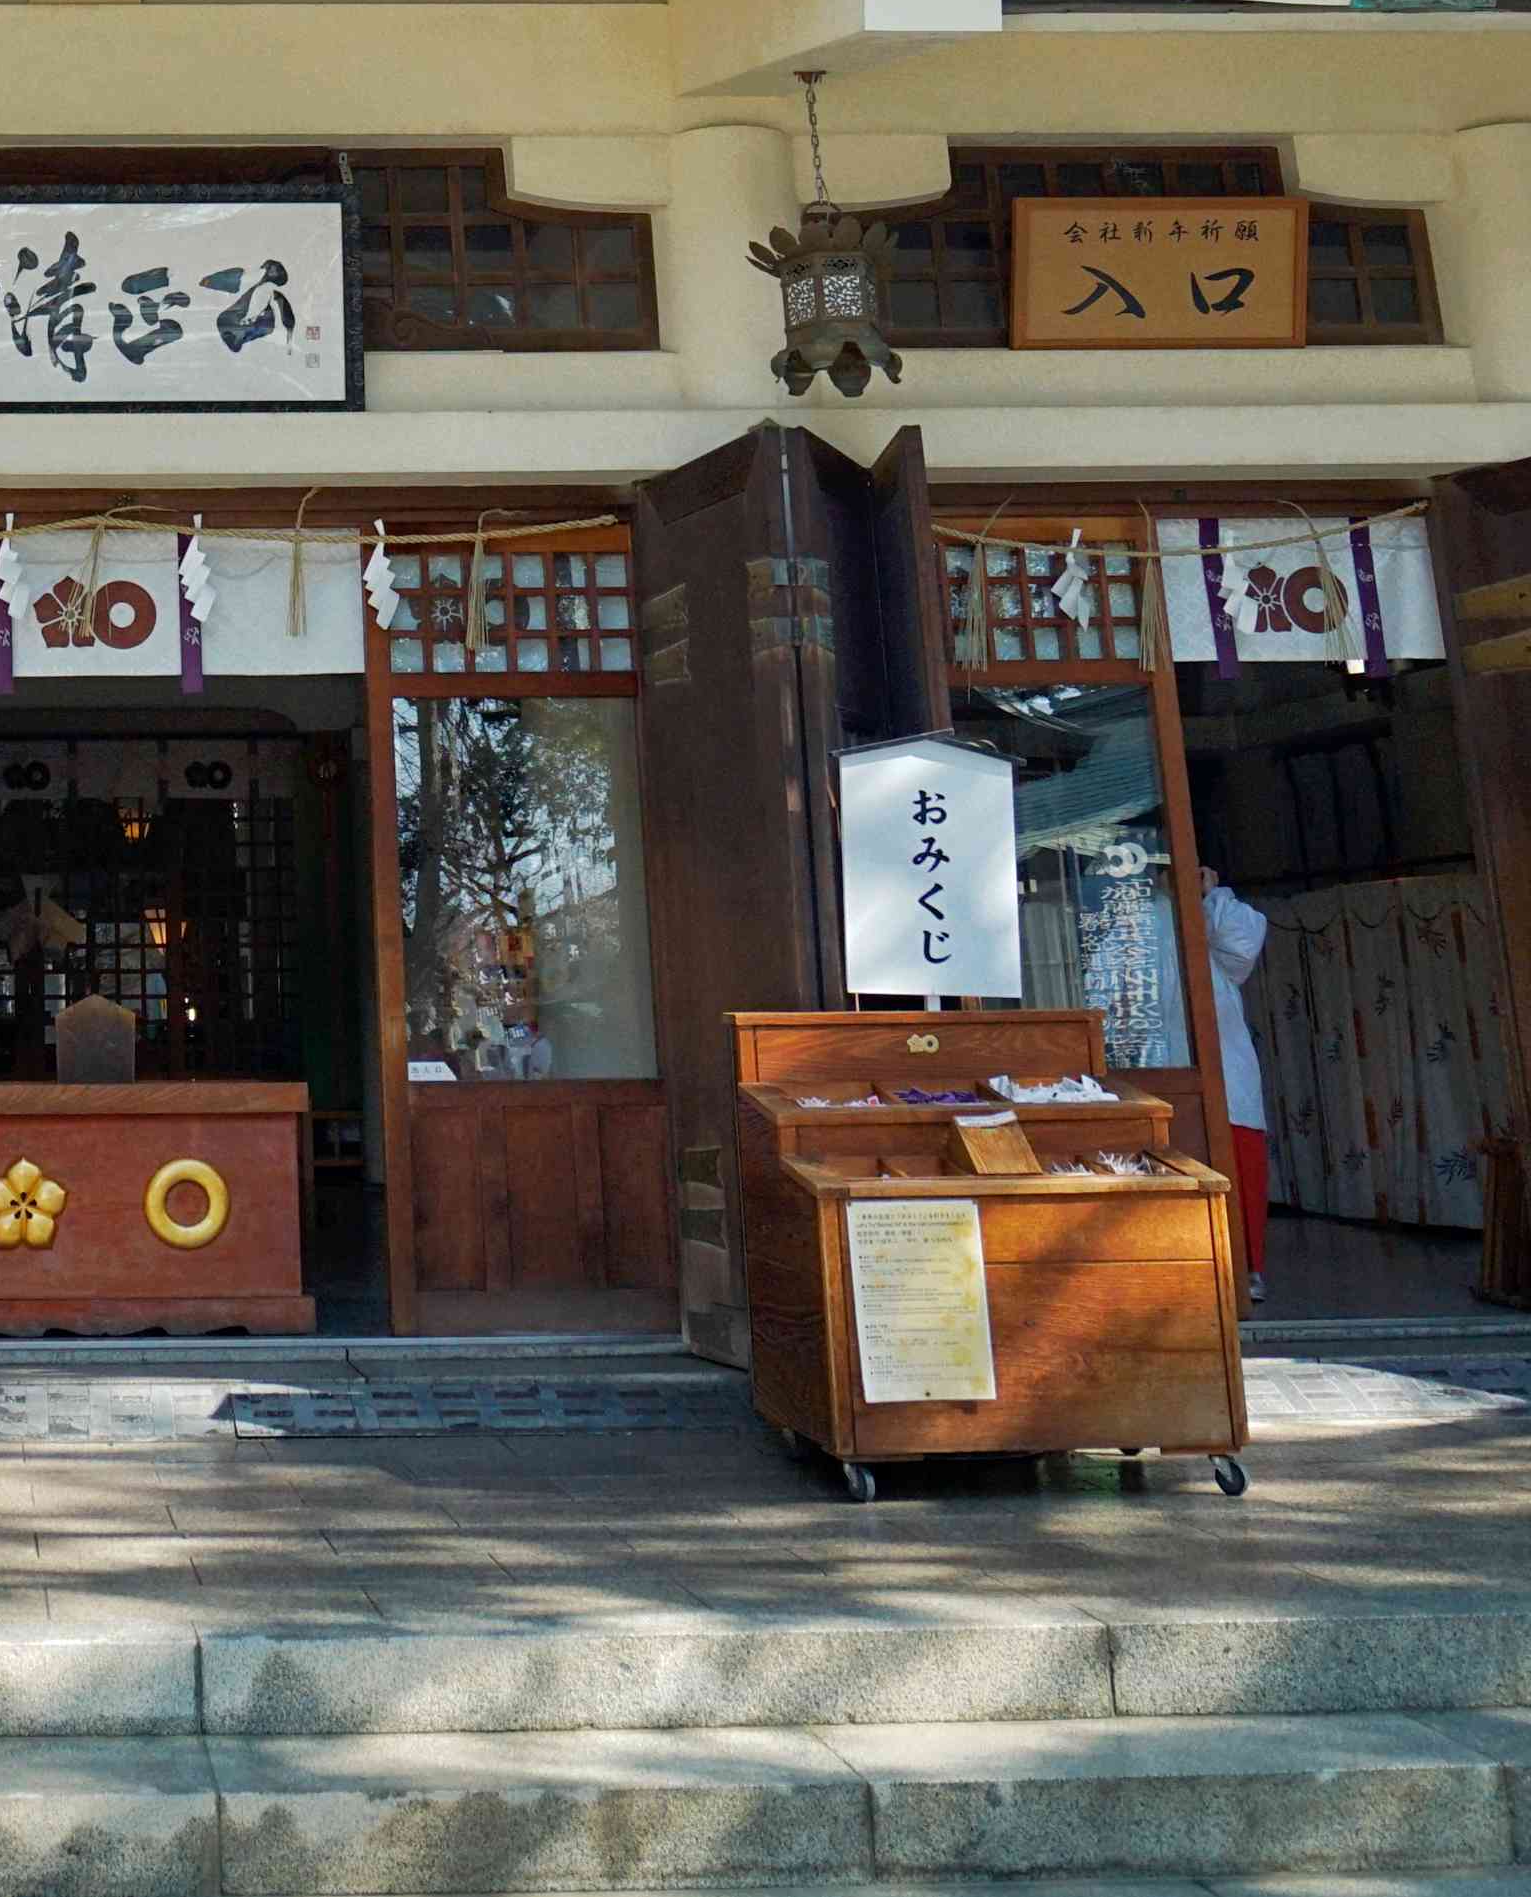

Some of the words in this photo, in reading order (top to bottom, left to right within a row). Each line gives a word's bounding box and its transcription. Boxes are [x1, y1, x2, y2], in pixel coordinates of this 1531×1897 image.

[1064, 219, 1259, 243] 会社新年祈願
[1061, 265, 1255, 318] 入口
[912, 790, 952, 964] おみくじ
